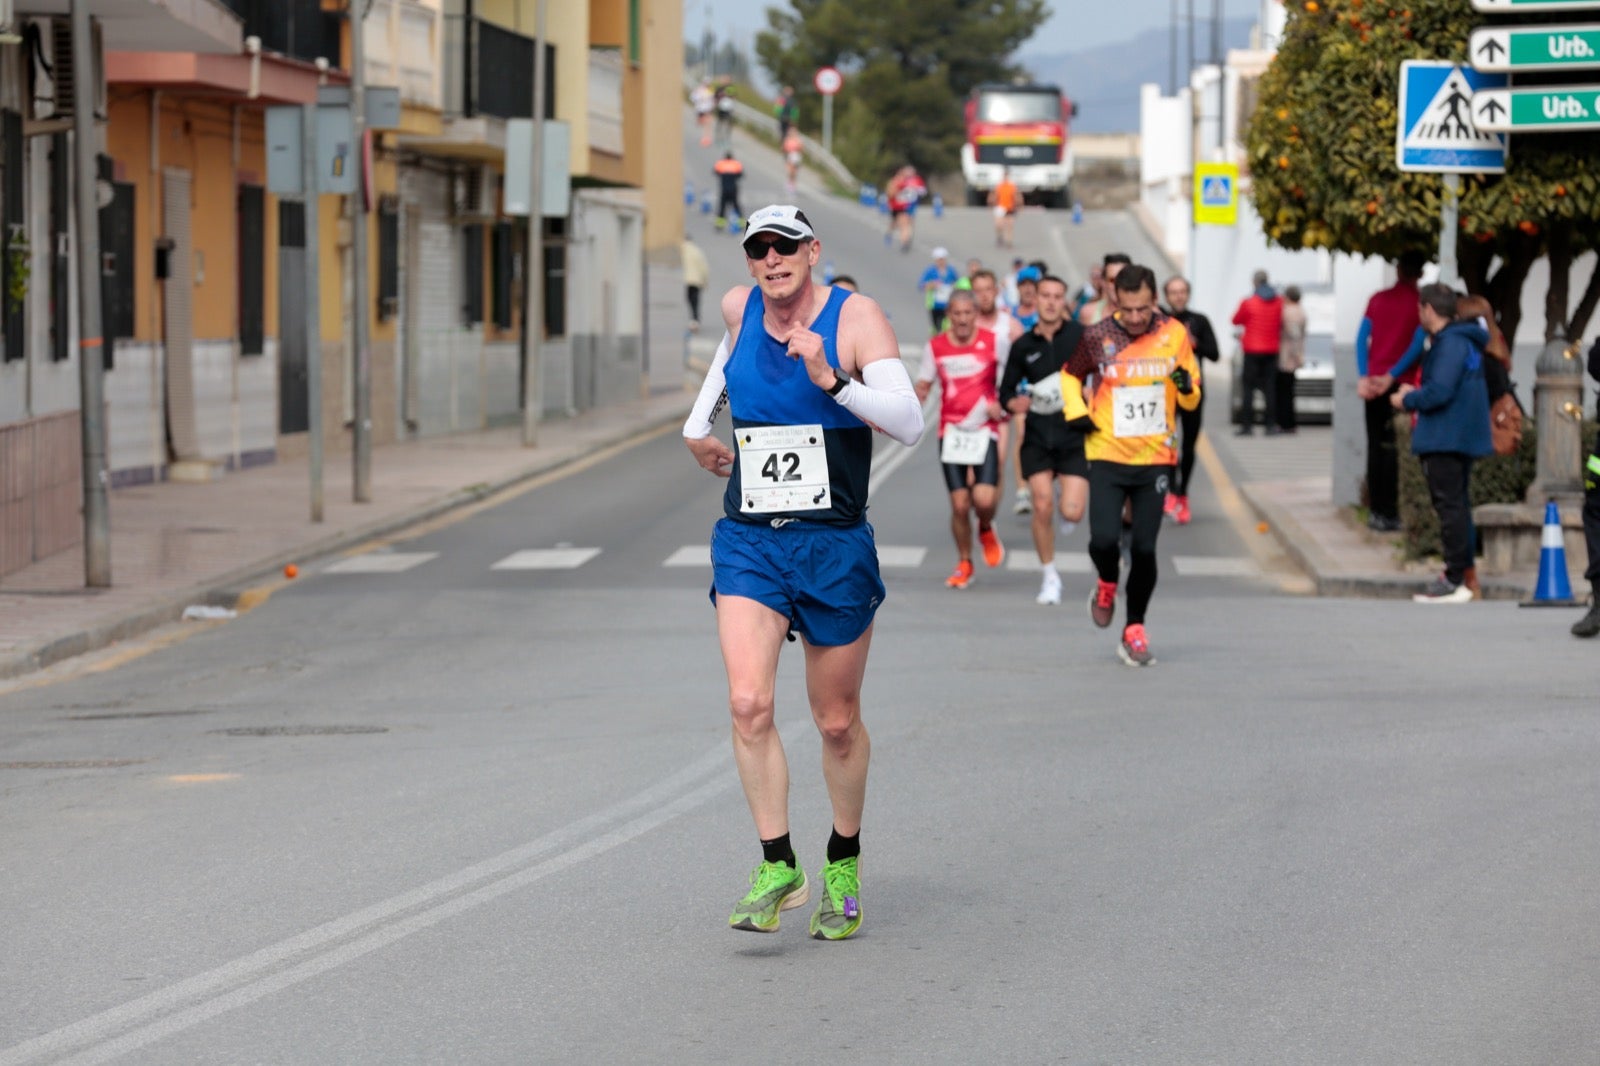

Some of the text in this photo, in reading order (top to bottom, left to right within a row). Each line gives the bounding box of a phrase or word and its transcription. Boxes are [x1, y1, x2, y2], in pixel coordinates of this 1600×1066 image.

[1548, 35, 1595, 59] Urb.
[1542, 95, 1589, 119] Urb.
[1124, 402, 1158, 420] 317
[761, 452, 803, 483] 42
